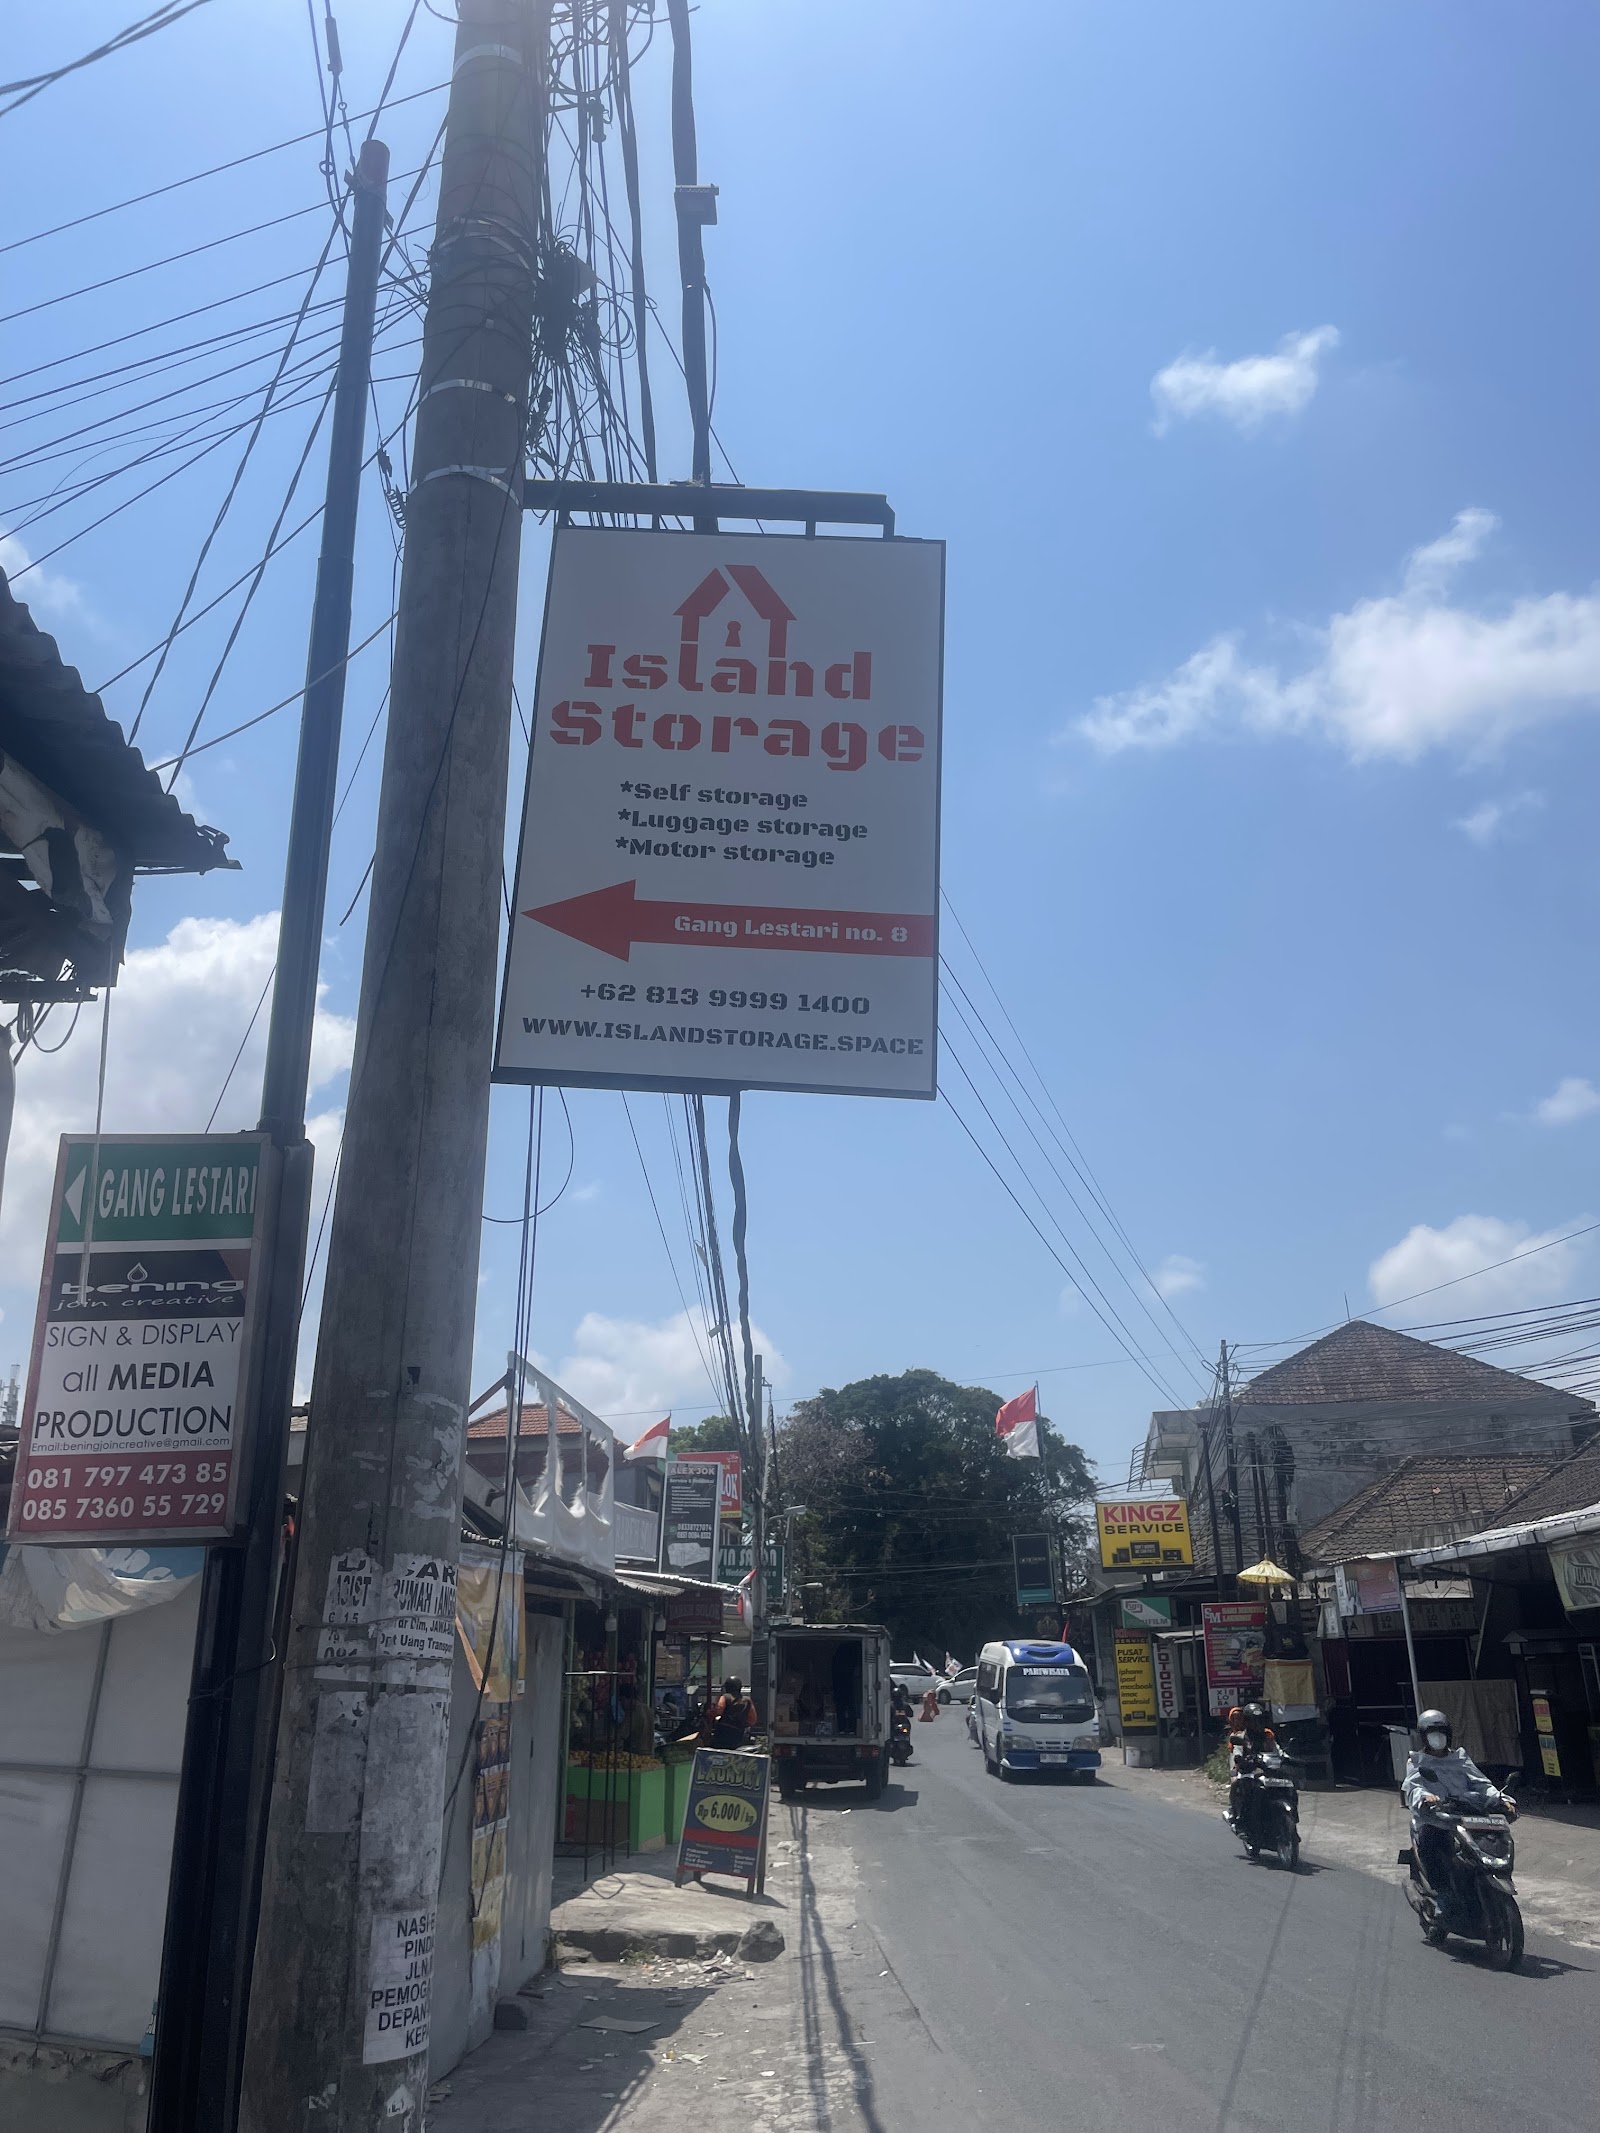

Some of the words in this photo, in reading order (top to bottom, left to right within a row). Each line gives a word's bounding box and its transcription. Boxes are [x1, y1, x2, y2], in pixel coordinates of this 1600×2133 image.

[584, 643, 872, 700] Island
[550, 701, 924, 771] Storage
[697, 787, 808, 811] storage
[757, 818, 868, 841] storage
[723, 844, 835, 868] storage
[674, 915, 738, 940] Gang
[744, 919, 839, 940] Lestari
[845, 926, 883, 942] no.
[890, 927, 908, 942] 8
[581, 983, 637, 1003] +62
[646, 985, 699, 1006] 813
[709, 989, 788, 1011] 9999
[797, 994, 870, 1016] 1400
[522, 1016, 924, 1056] WWW.ISLANDSTORAGE.SPACE
[99, 1166, 166, 1219] GANG
[171, 1165, 258, 1216] LESTARI
[61, 1278, 245, 1296] bening
[52, 1297, 110, 1312] join
[121, 1294, 236, 1308] creative
[47, 1326, 107, 1348] SIGN
[116, 1325, 133, 1346] &
[142, 1321, 241, 1346] DISPLAY
[63, 1364, 99, 1393] all
[108, 1360, 215, 1391] MEDIA
[34, 1405, 231, 1439] PRODUCTION
[27, 1467, 72, 1490] 081
[84, 1466, 131, 1488] 797
[139, 1464, 187, 1485] 473
[196, 1462, 227, 1483] 85
[721, 1473, 738, 1500] LOK
[23, 1499, 67, 1520] 085
[76, 1497, 134, 1519] 7360
[143, 1495, 171, 1516] 55
[180, 1493, 224, 1515] 729
[1103, 1504, 1181, 1523] KINGZ
[1104, 1523, 1184, 1535] SERVICE
[718, 1549, 735, 1566] VIN
[401, 1634, 425, 1651] Uang
[1117, 1648, 1143, 1656] PUSAT
[1023, 1667, 1070, 1676] PARIWISATA
[1118, 1656, 1150, 1664] SERVICE
[1157, 1643, 1173, 1717] FOTOCOPY
[697, 1805, 708, 1821] Rp
[710, 1801, 739, 1820] 6.000
[397, 1915, 429, 1938] NASI
